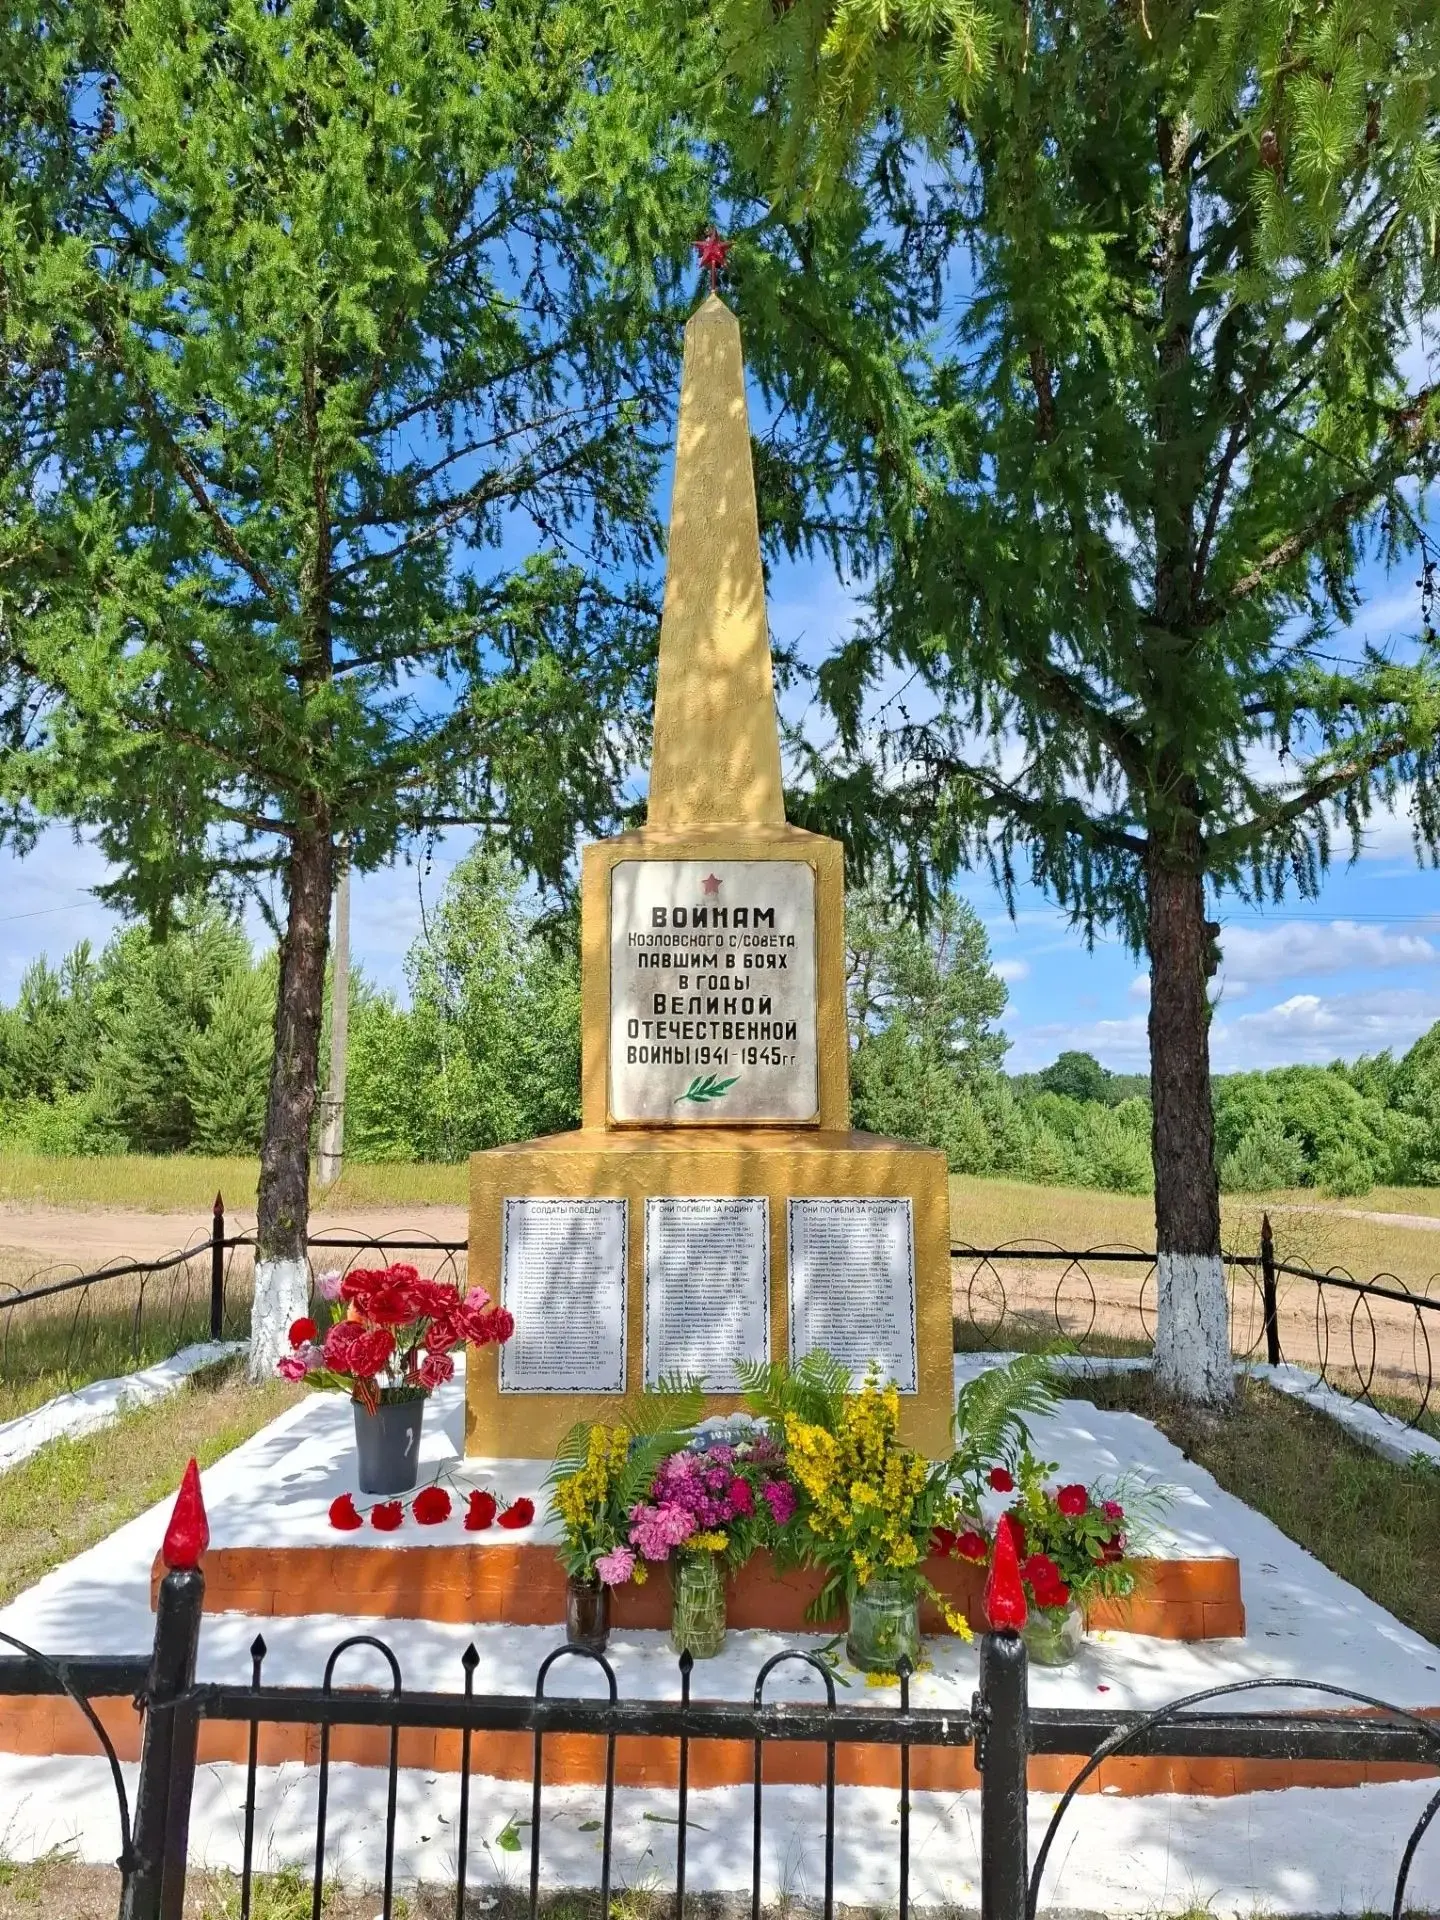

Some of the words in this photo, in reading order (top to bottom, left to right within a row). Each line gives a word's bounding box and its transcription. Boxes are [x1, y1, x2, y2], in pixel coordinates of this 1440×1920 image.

[652, 907, 775, 928] ВОИНАМ
[638, 953, 718, 968] ПАВШИМ
[726, 953, 736, 968] В
[744, 953, 788, 968] БОЯХ
[679, 975, 689, 990] В
[697, 975, 750, 990] ГОДЫ
[653, 994, 772, 1015] ВЕЛИКОЙ
[531, 1206, 567, 1214] СОЛДАТЫ
[569, 1206, 602, 1214] ПОБЕДЫ
[659, 1205, 675, 1213] ОНИ
[676, 1205, 711, 1213] ПОГИБЛИ
[713, 1205, 723, 1213] ЗА
[724, 1205, 753, 1213] РОДИНУ
[802, 1206, 819, 1214] ОНИ
[820, 1206, 855, 1214] ПОГИБЛИ
[856, 1206, 867, 1214] ЗА
[868, 1206, 898, 1214] РОДИНУ
